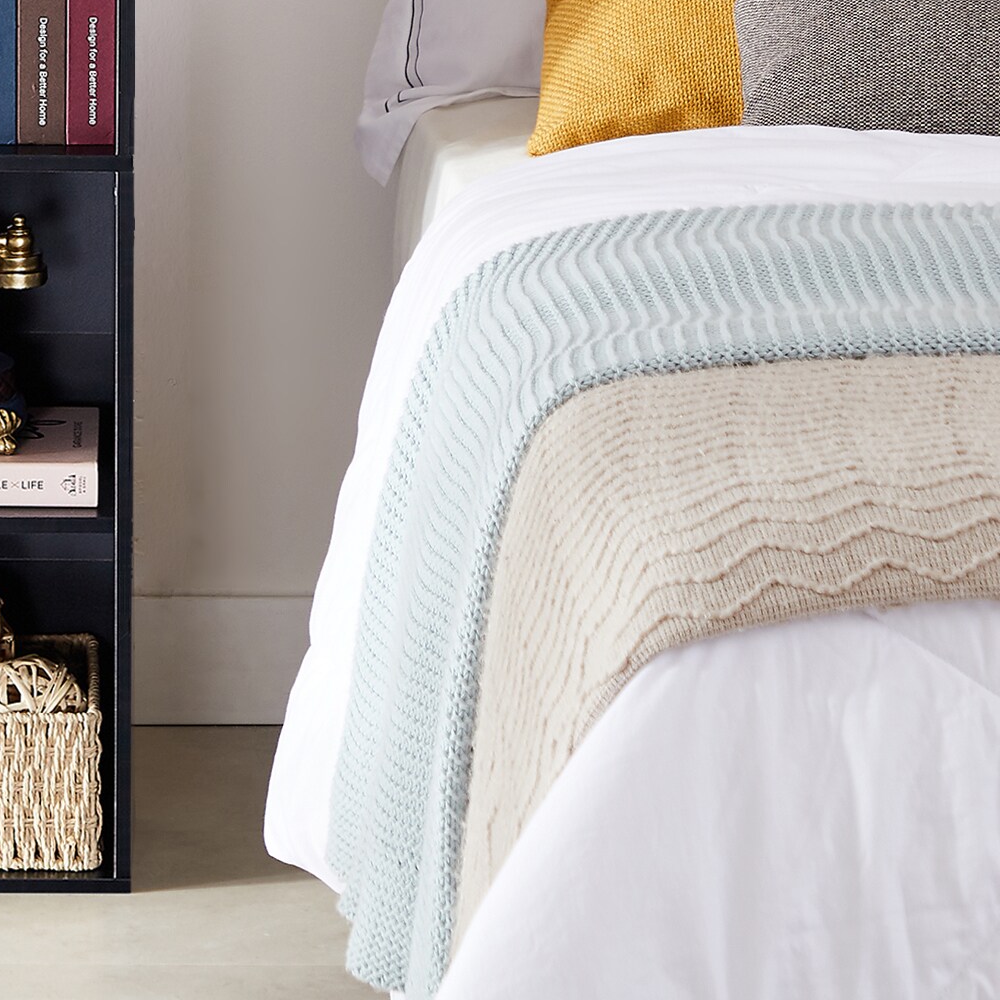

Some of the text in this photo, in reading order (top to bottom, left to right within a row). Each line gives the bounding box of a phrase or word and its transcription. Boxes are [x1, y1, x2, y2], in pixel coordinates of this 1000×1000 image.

[37, 17, 48, 48] Design
[87, 17, 98, 48] Design
[38, 49, 49, 63] for
[88, 49, 98, 63] for
[38, 71, 48, 98] Better
[88, 71, 98, 98] Better
[38, 99, 48, 126] Home
[88, 99, 98, 126] Home
[21, 479, 44, 490] LIFE
